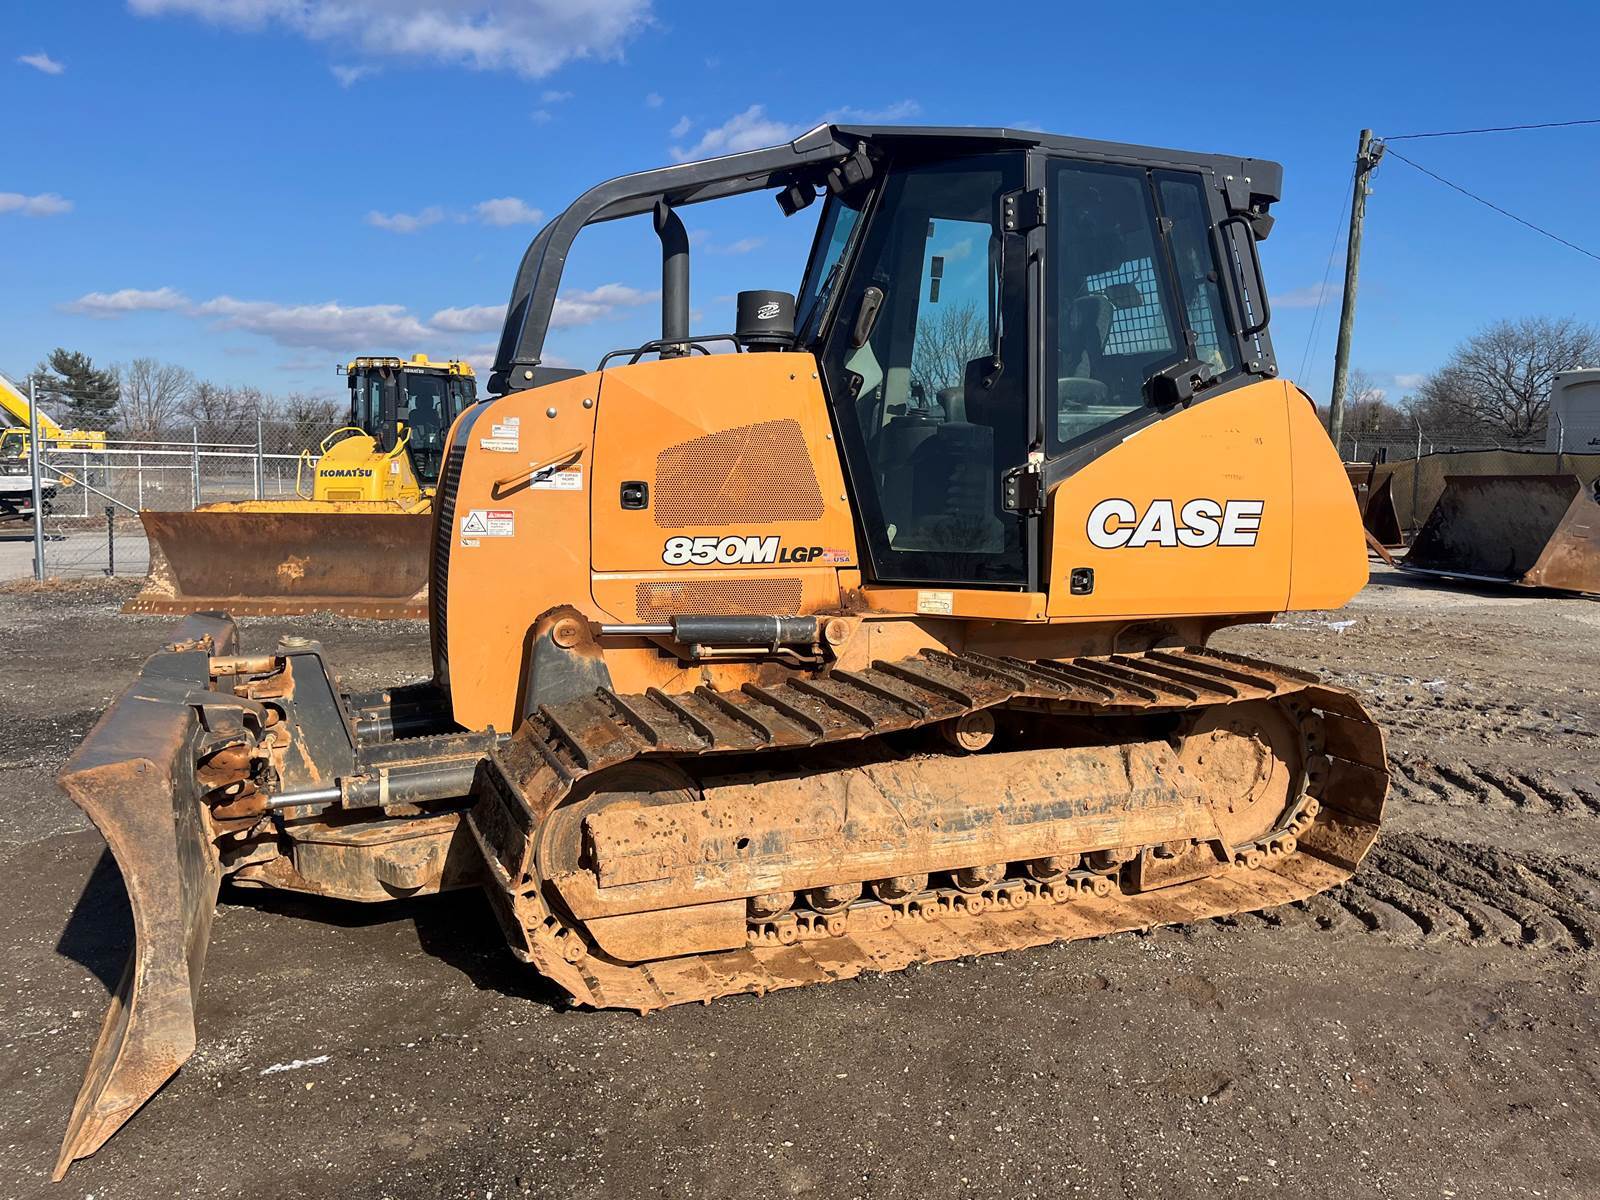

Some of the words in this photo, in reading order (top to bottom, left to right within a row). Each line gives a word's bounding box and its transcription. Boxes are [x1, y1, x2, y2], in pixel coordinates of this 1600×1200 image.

[320, 468, 373, 477] KOMATSU
[1086, 498, 1264, 549] CASE
[662, 536, 781, 565] 850M
[779, 547, 823, 563] LGP
